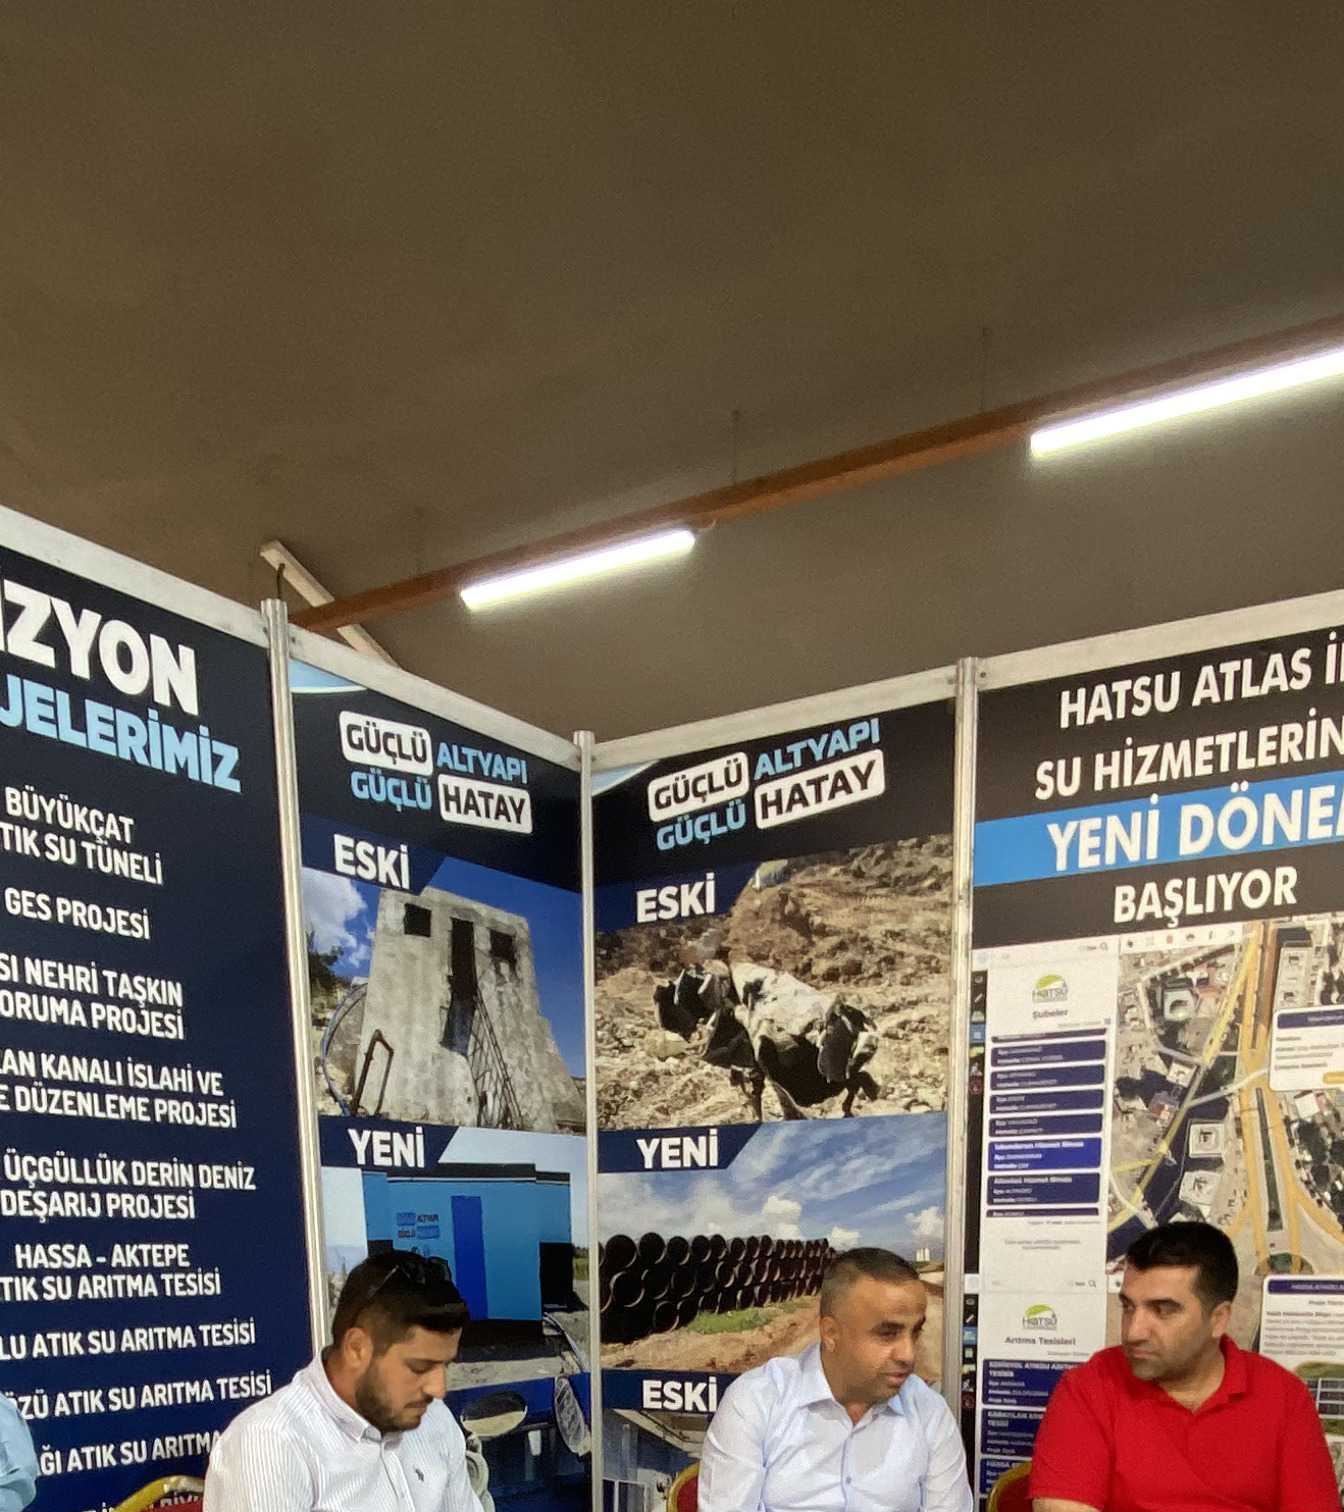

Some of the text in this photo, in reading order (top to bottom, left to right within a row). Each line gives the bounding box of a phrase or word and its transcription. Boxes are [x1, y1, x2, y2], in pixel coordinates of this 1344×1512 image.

[1060, 671, 1181, 729] HATSU
[1192, 648, 1312, 708] ATLAS
[346, 720, 528, 784] GÜÇLÜ ALTYAPI
[653, 717, 881, 810] GÜÇLÜ ALTYAPI
[350, 767, 526, 825] GÜÇLÜ HATAY
[1035, 757, 1081, 801] SU
[4, 785, 135, 844] BÜYÜKÇAT
[656, 759, 877, 852] GÜÇLÜ HATAY
[1047, 793, 1160, 872] YENİ
[45, 833, 78, 866] SU
[82, 837, 164, 886] TÜNELİ
[333, 833, 410, 890] ESKİ
[4, 887, 151, 941] GES PROJESİ
[636, 872, 716, 924] ESKİ
[1113, 866, 1298, 930] BAŞLIYOR
[25, 957, 99, 996] NEHRİ
[102, 968, 183, 1008] TAŞKIN
[91, 1002, 186, 1041] PROJESİ
[40, 1052, 124, 1086] KANALI
[127, 1056, 194, 1094] İSLAHİ
[197, 1069, 225, 1097] VE
[16, 1080, 152, 1123] DÜZENLEME
[154, 1098, 238, 1129] PROJESİ
[3, 1147, 128, 1189] ÜÇGÜLLÜK
[131, 1157, 195, 1188] DERİN
[198, 1160, 257, 1192] DENİZ
[347, 1126, 425, 1169] YENİ
[637, 1127, 719, 1170] YENİ
[0, 1189, 196, 1224] DEŞARIJ PROJESİ
[15, 1244, 92, 1270] HASSA
[111, 1243, 191, 1269] AKTEPE
[42, 1274, 73, 1301] SU
[76, 1272, 159, 1300] ARITMA
[160, 1266, 222, 1298] TESİSİ
[31, 1330, 85, 1358] ATIK
[88, 1330, 117, 1355] SU
[120, 1325, 197, 1353] ARITMA
[199, 1316, 257, 1348] TESİSİ
[54, 1390, 106, 1418] ATIK
[108, 1385, 136, 1412] SU
[140, 1379, 215, 1409] ARITMA
[216, 1369, 273, 1401] TESİSİ
[642, 1376, 718, 1413] ESKİ
[36, 1443, 63, 1477] ĞI
[66, 1445, 117, 1473] ATIK
[119, 1440, 149, 1467] SU
